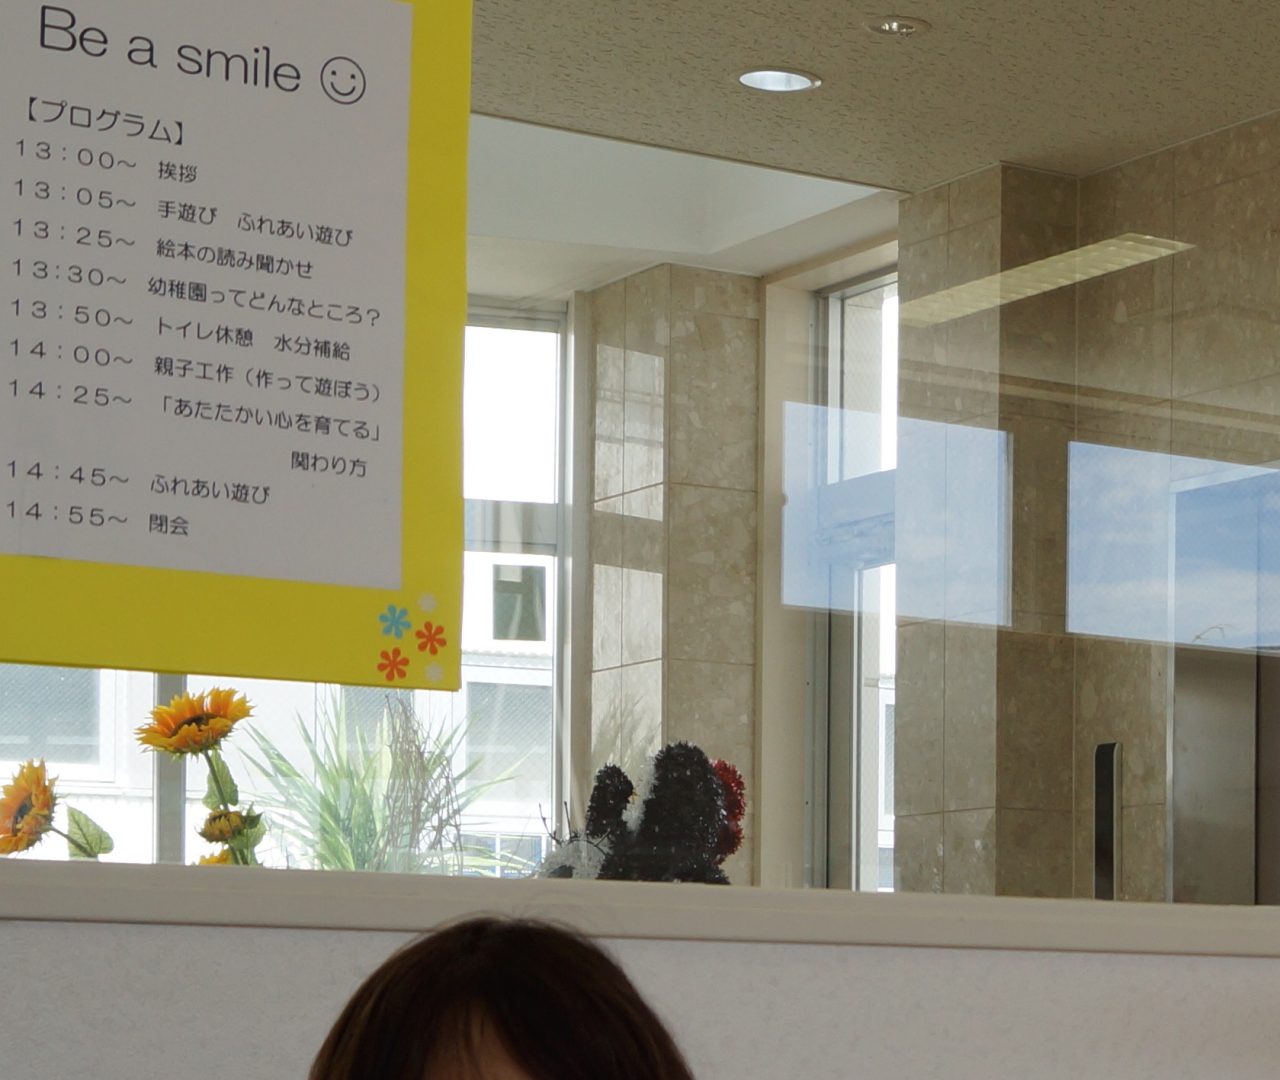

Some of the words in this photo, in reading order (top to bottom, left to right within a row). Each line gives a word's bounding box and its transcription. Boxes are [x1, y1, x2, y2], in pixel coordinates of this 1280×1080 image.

[38, 4, 108, 58] Be
[125, 34, 159, 69] a
[175, 43, 301, 93] smile
[28, 96, 183, 146] 【プログラム】
[157, 159, 199, 184] 挨拶
[157, 199, 218, 226] 手遊び
[236, 212, 354, 247] ふれあい遊び
[156, 237, 314, 280] 絵本の読み聞かせ
[147, 276, 381, 328] 幼稚園ってどんなところ?
[158, 316, 253, 348] トイレ休憩
[273, 333, 351, 362] 水分補給
[162, 395, 380, 442] 「あたたかい心を育てる」
[290, 450, 368, 478] 関わり方
[150, 473, 271, 505] ふれあい遊び
[148, 512, 190, 537] 閉会
